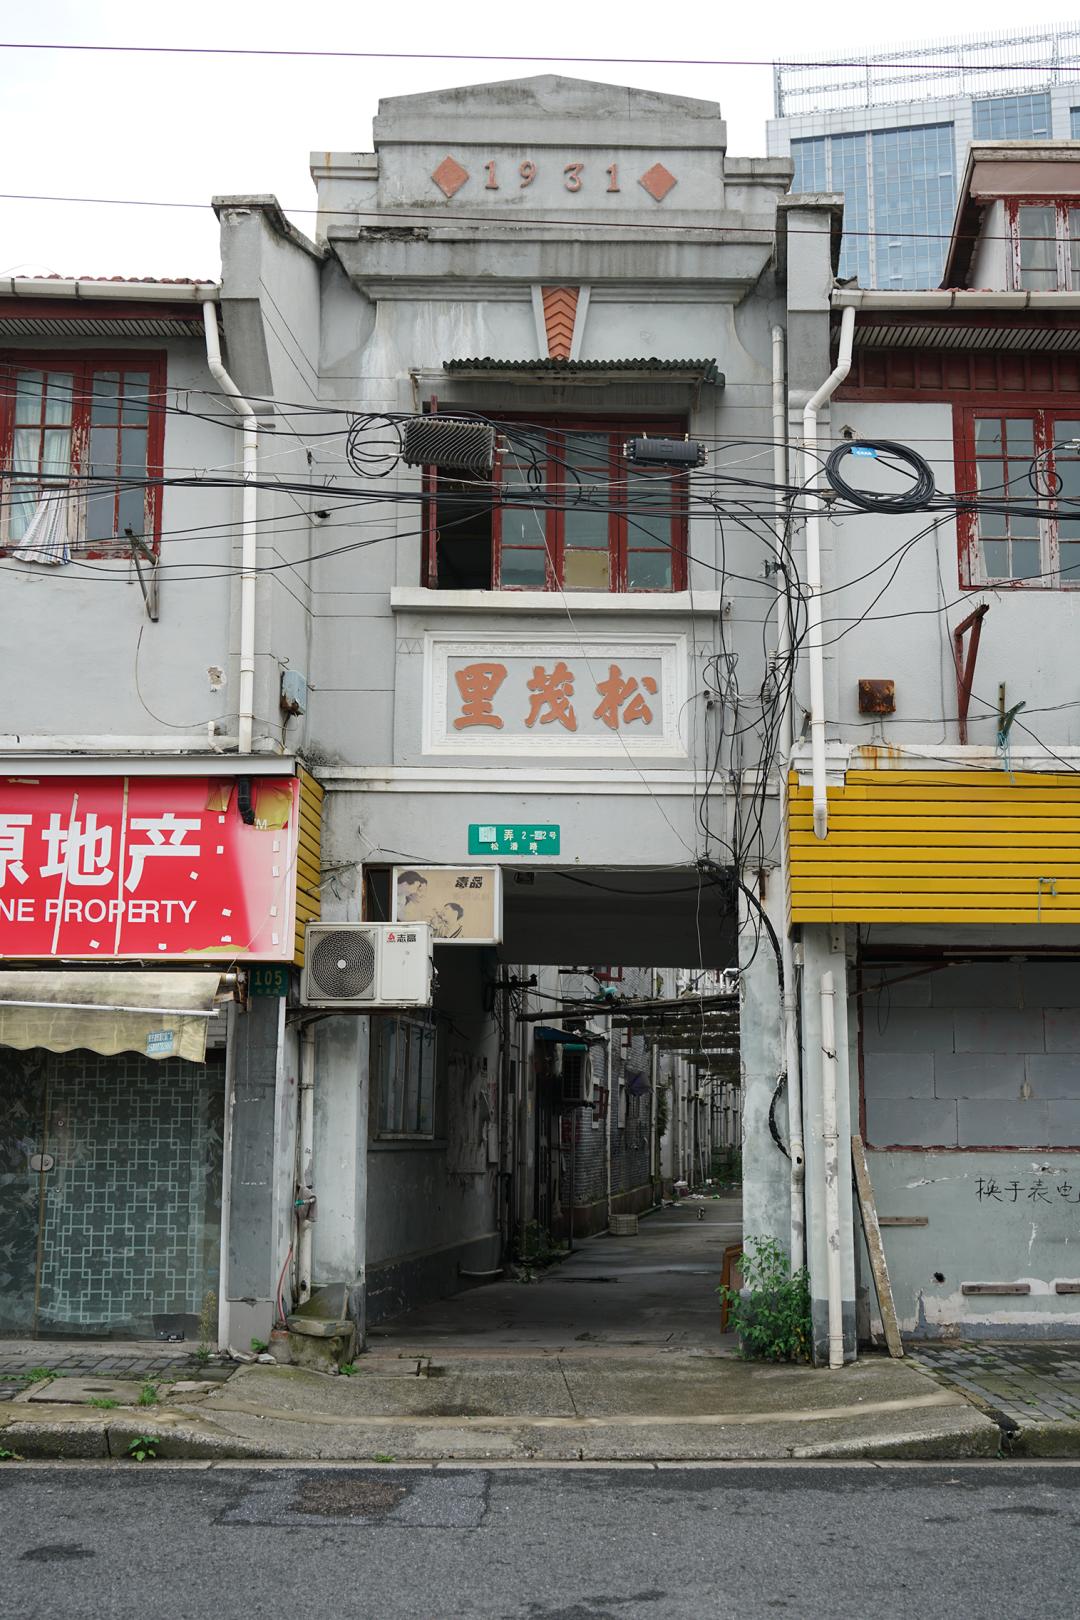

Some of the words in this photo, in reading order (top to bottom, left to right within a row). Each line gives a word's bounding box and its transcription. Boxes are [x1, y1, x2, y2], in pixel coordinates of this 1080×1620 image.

[484, 160, 621, 193] 1931
[45, 898, 197, 923] PROPERTY
[255, 970, 282, 986] 105
[974, 1177, 1080, 1204] 换手表电
